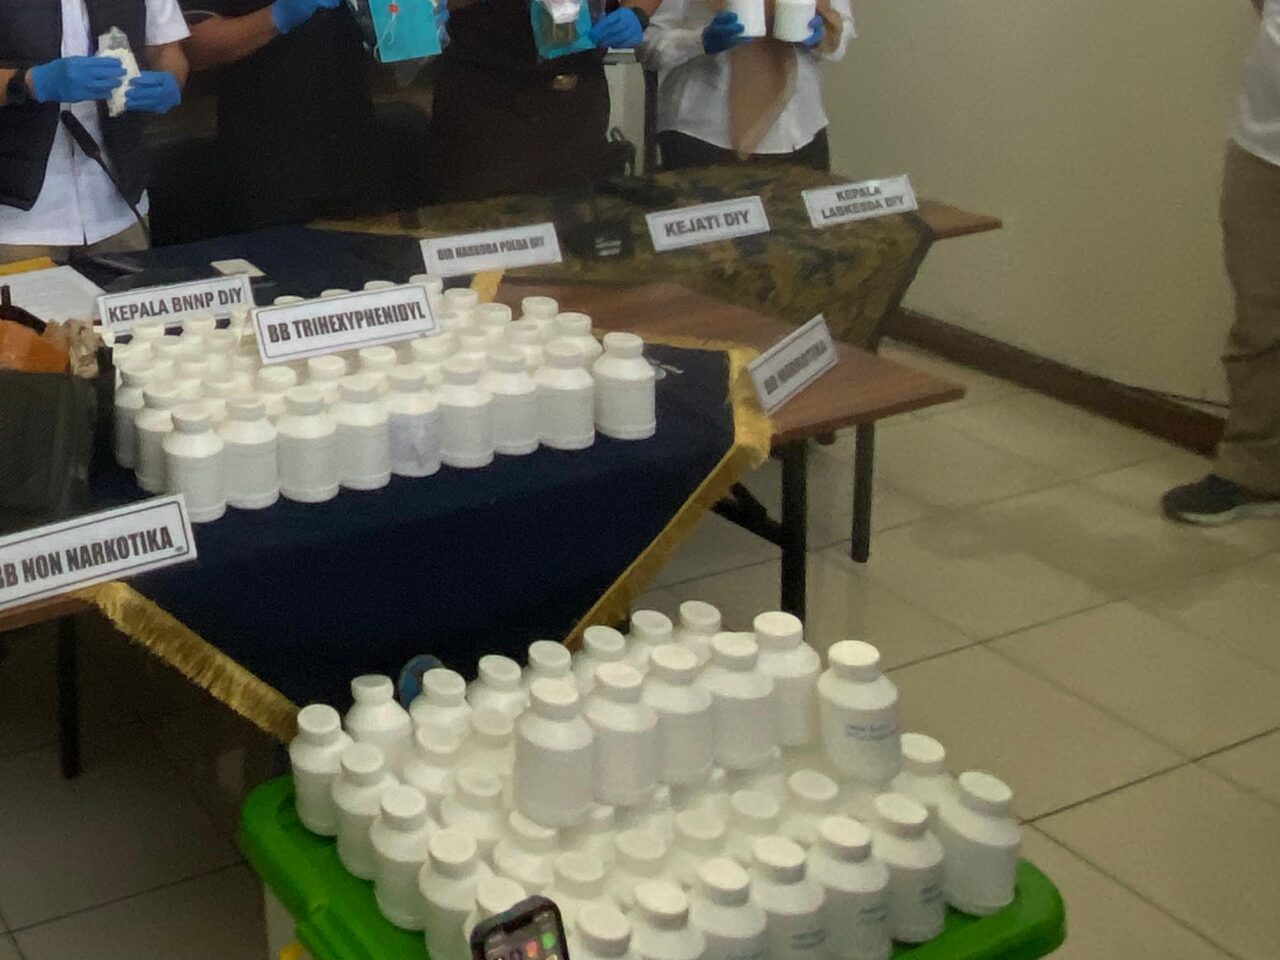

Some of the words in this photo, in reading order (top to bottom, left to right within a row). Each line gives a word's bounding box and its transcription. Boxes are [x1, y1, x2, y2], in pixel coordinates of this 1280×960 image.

[664, 215, 720, 237] KEJATI
[723, 210, 749, 226] DIY
[108, 299, 169, 324] KEPALA
[172, 291, 215, 313] BNNP
[218, 287, 242, 305] DIY
[267, 321, 291, 343] BB
[294, 301, 426, 339] TRIHEXYPHENIDYL
[21, 549, 63, 583] NON
[66, 526, 174, 571] NARKOTIKA
